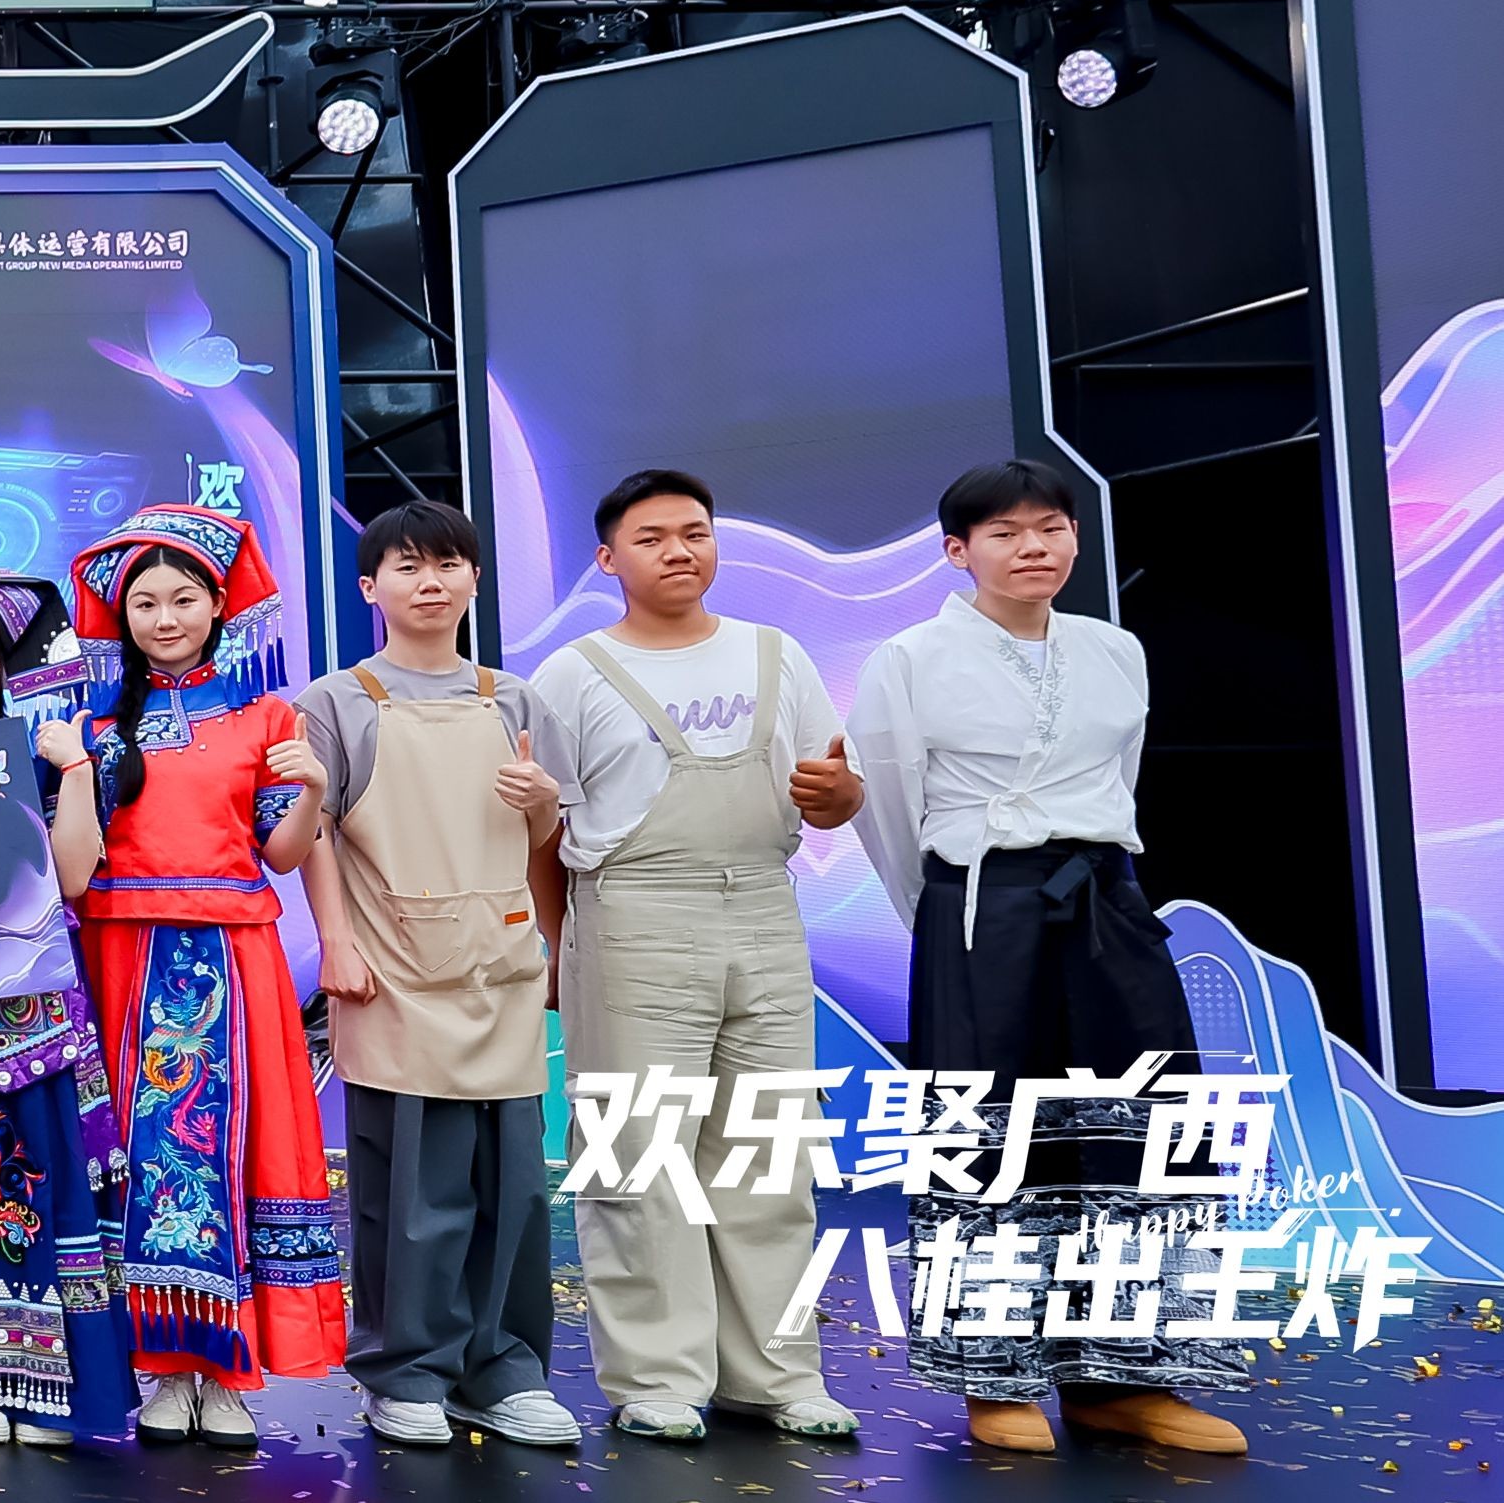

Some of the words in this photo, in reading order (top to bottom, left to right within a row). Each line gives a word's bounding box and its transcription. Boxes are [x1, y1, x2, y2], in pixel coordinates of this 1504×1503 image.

[5, 261, 37, 270] GROUP
[62, 260, 92, 270] MEDIA
[92, 260, 144, 270] OPERATING
[145, 260, 183, 270] LIMITED
